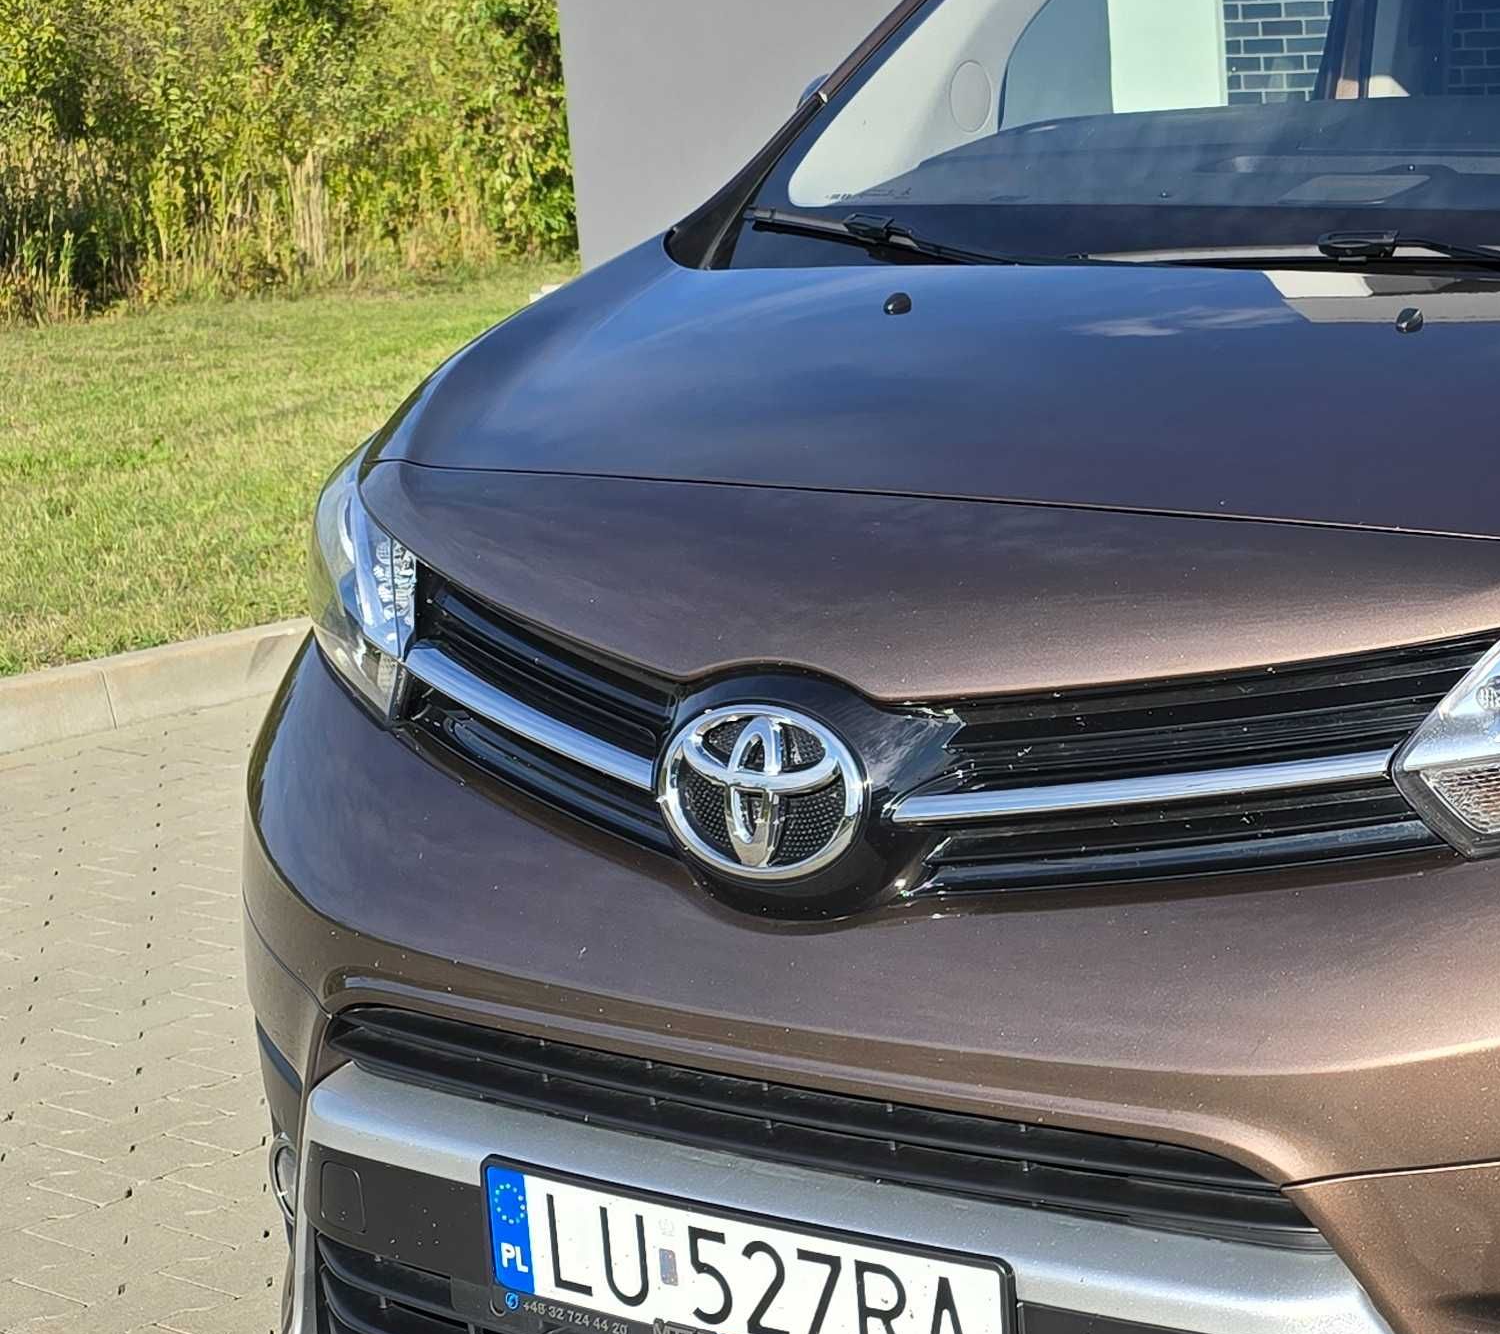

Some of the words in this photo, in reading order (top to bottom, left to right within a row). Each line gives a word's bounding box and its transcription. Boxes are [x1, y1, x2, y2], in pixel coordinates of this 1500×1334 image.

[500, 1241, 529, 1274] PL
[546, 1193, 649, 1307] LU
[549, 1307, 564, 1321] 32
[567, 1310, 590, 1326] 724
[593, 1317, 609, 1332] 44
